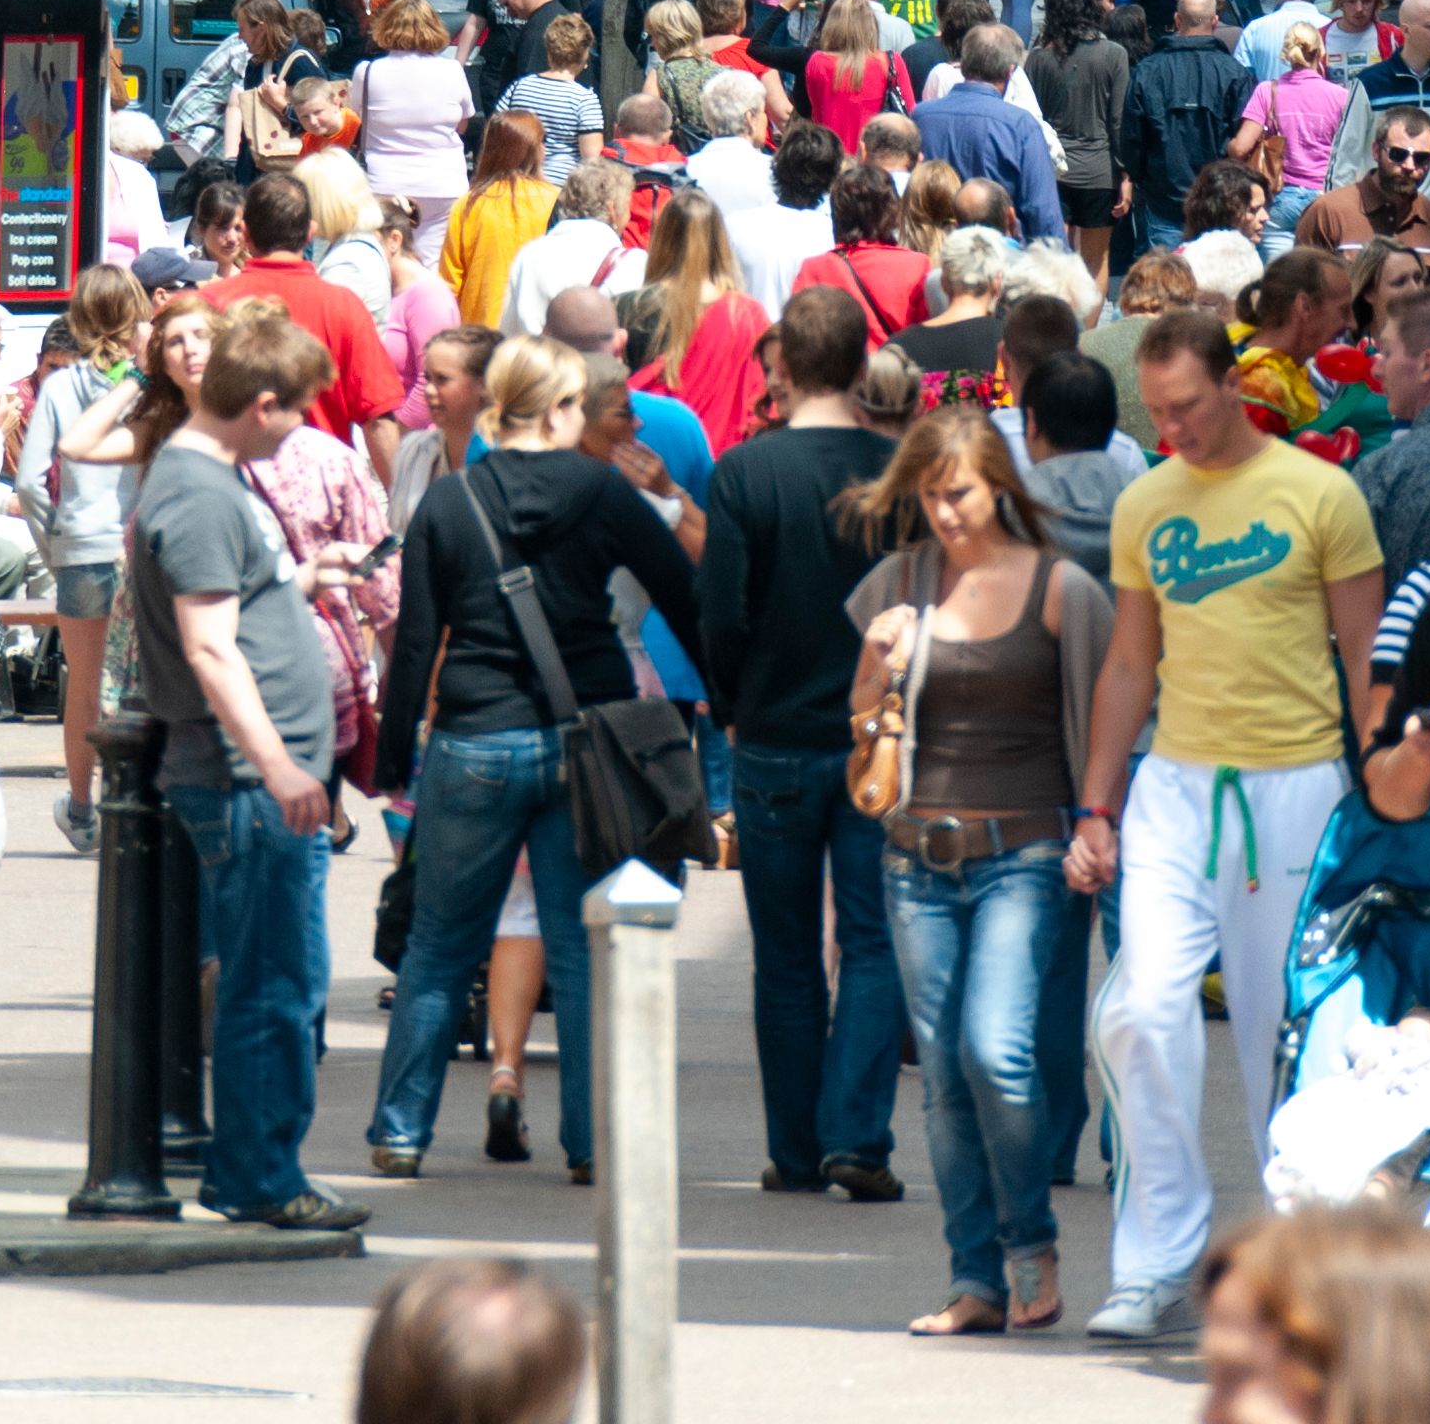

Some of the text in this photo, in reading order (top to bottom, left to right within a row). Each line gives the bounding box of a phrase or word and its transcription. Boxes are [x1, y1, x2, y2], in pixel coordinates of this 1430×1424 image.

[19, 186, 72, 203] standard
[1, 212, 68, 226] Confectionery
[9, 233, 58, 245] Ice cream
[11, 253, 54, 268] Pop corn
[7, 274, 57, 286] Soft drinks
